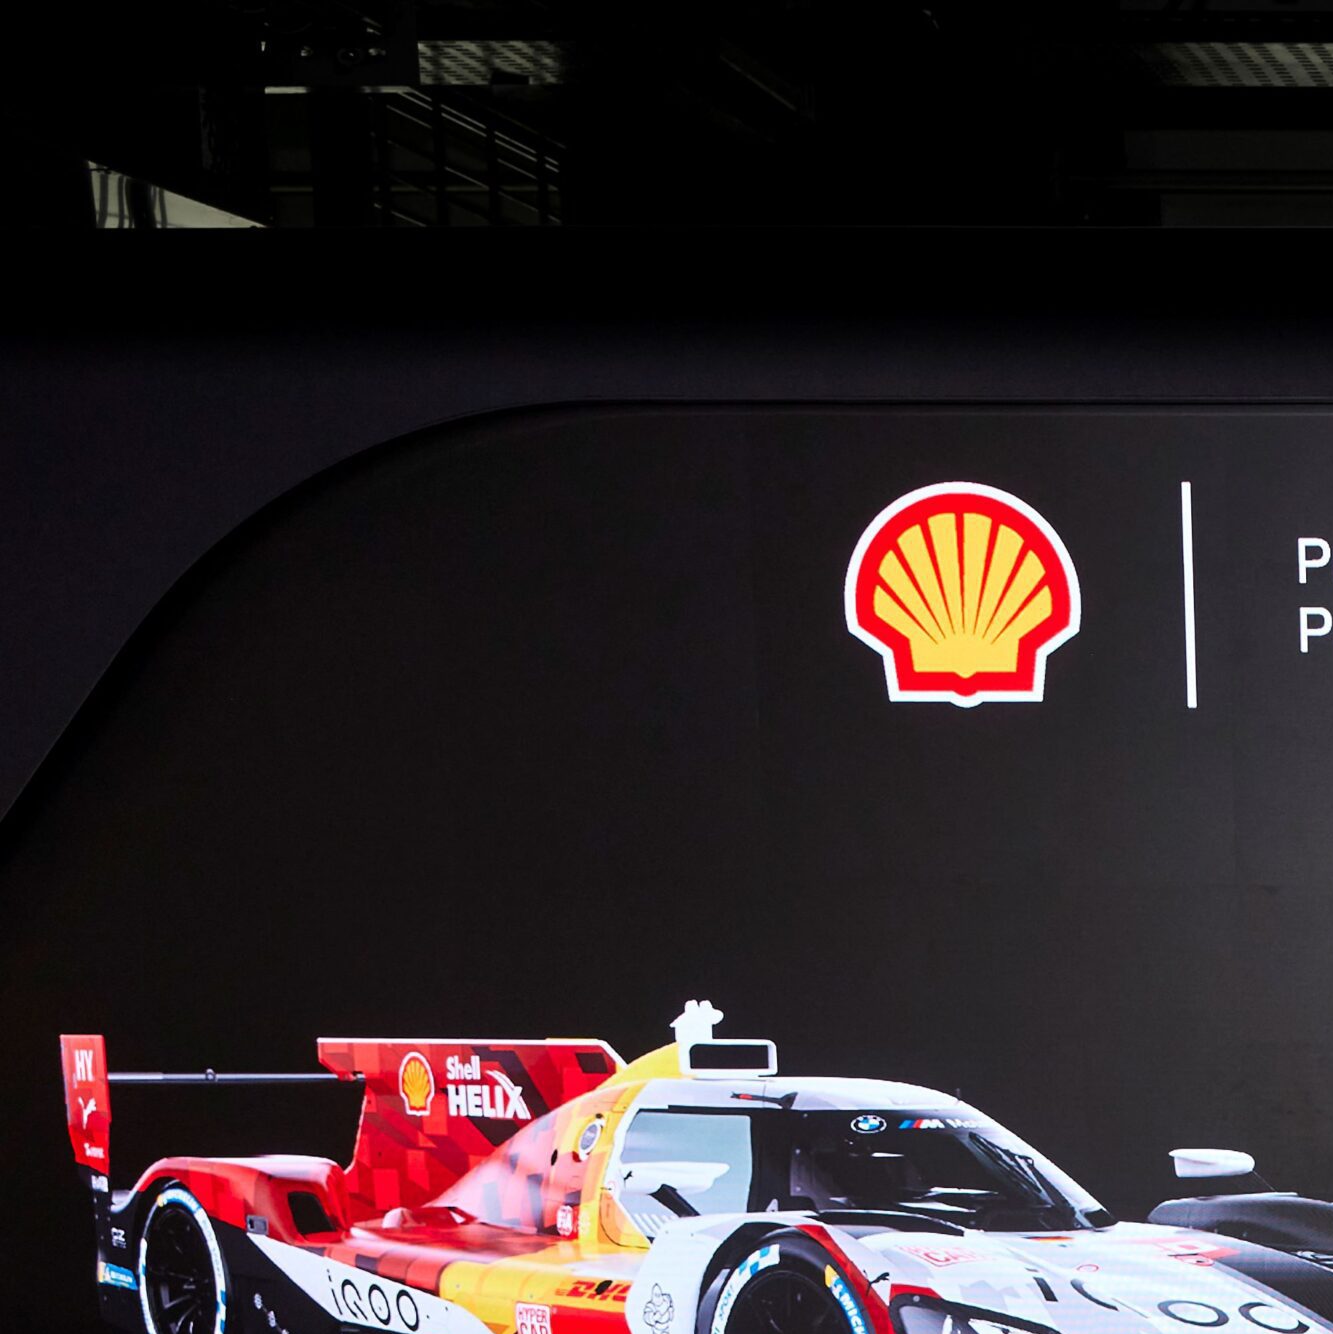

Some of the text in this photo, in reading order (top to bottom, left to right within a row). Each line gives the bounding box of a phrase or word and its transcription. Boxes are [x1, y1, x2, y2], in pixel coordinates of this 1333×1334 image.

[75, 1049, 93, 1081] HY
[446, 1056, 480, 1080] Shell
[447, 1084, 531, 1120] HELIX
[518, 1306, 547, 1324] HYPER
